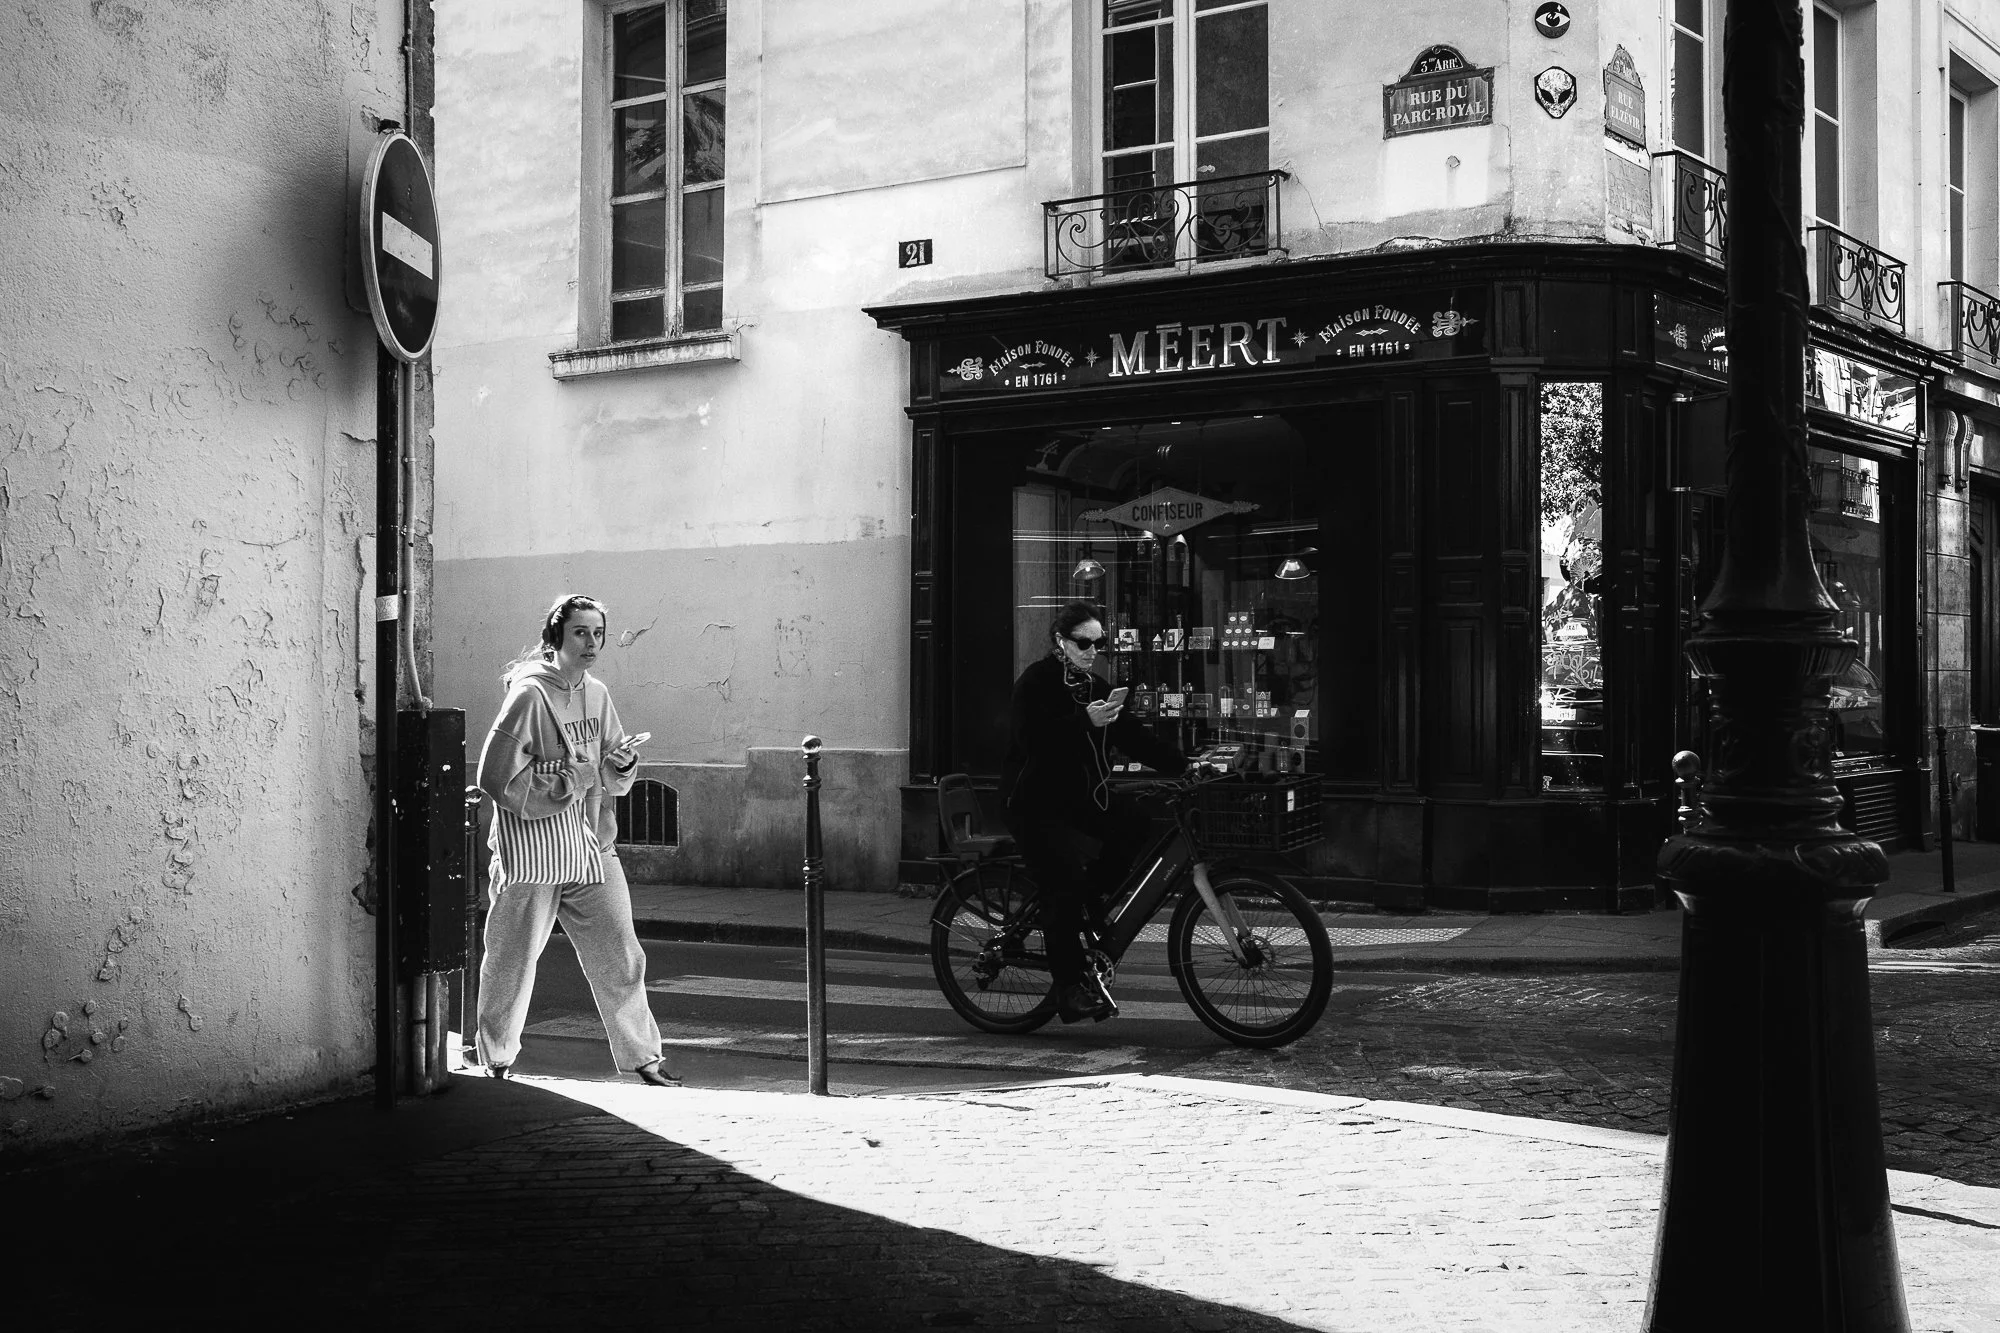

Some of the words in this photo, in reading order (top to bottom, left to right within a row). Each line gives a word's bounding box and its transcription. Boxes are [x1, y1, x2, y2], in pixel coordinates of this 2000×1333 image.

[1410, 89, 1442, 106] RUE
[1446, 85, 1468, 101] DU
[1618, 91, 1633, 110] RUE
[1392, 101, 1485, 126] PARC-ROYAL
[905, 241, 926, 266] 21
[1349, 344, 1365, 358] EN
[1370, 341, 1400, 356] 1761
[1015, 374, 1029, 388] EN
[1033, 372, 1058, 386] 1761
[1131, 502, 1203, 523] CONFISEUR
